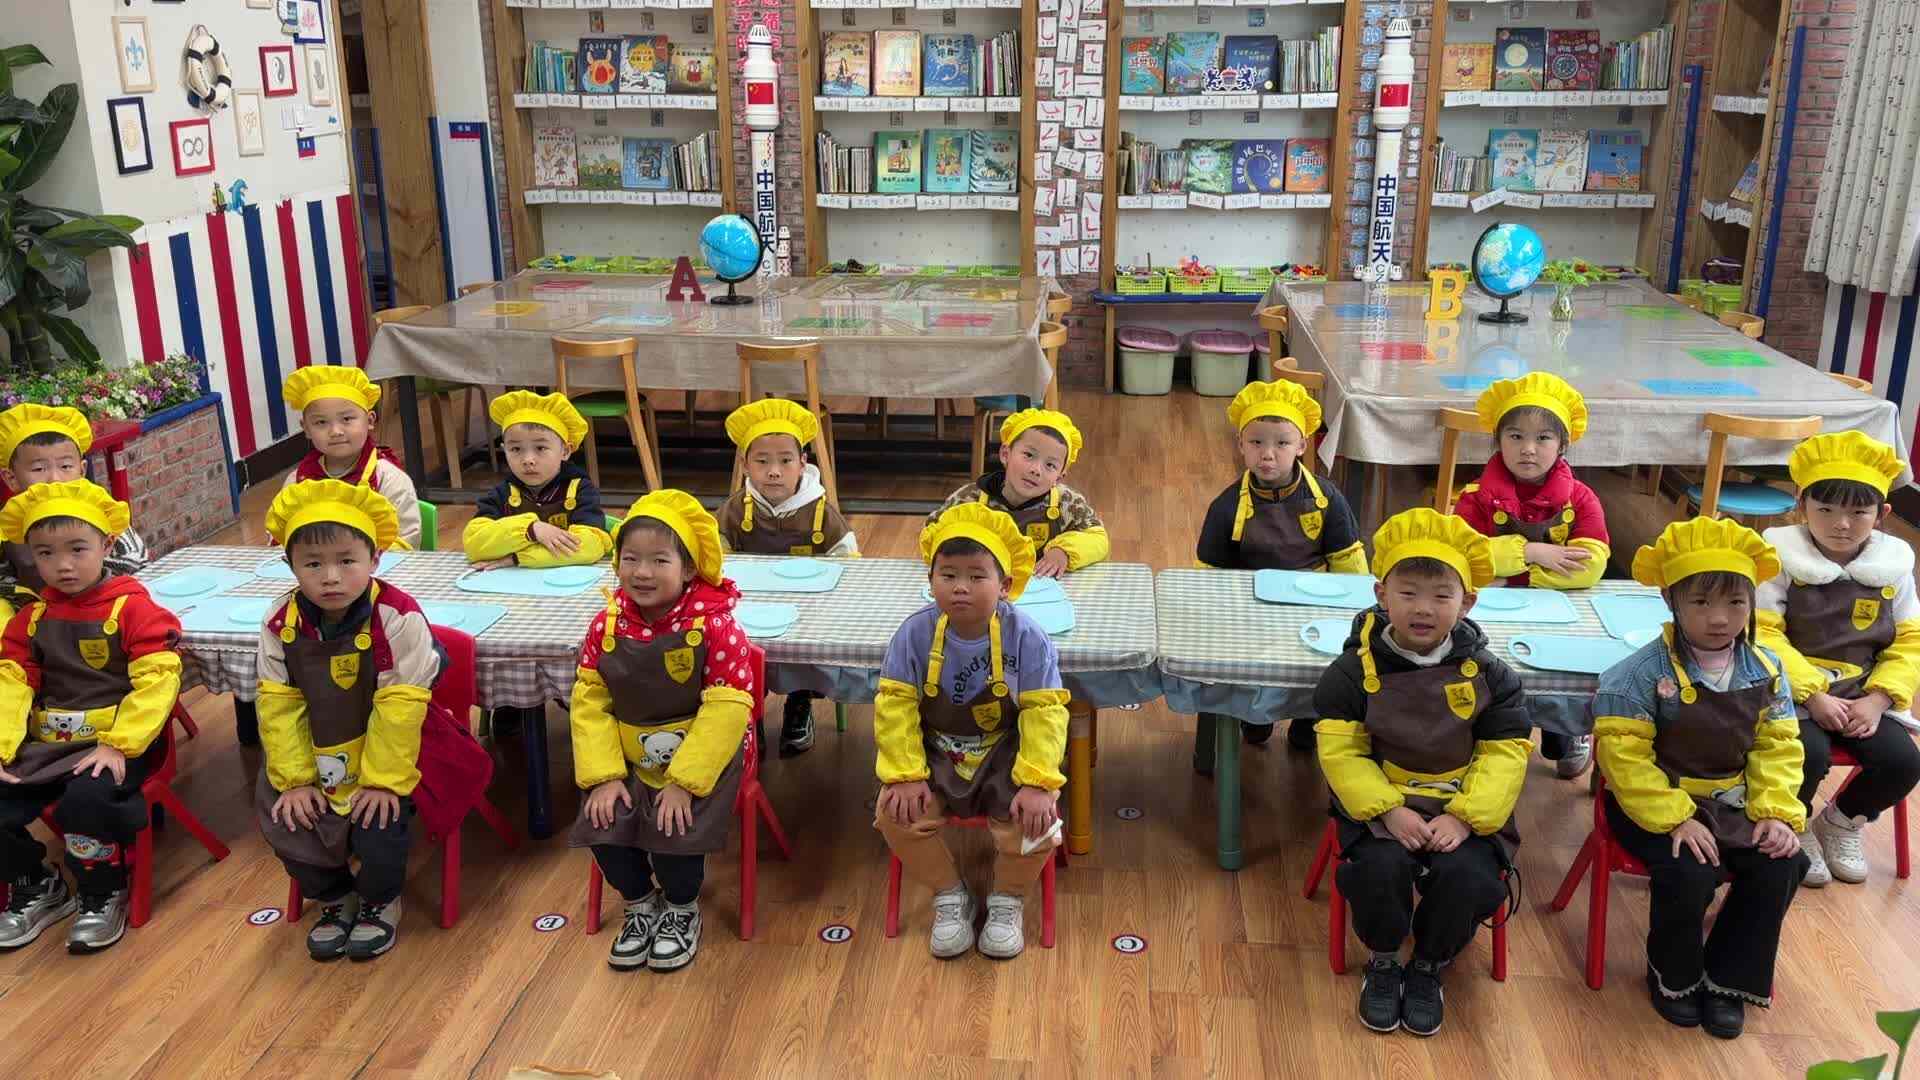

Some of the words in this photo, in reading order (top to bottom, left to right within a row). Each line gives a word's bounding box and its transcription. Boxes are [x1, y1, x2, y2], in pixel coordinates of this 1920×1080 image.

[757, 169, 774, 253] 中国航天
[1372, 174, 1396, 263] 中国航天
[666, 256, 705, 301] A
[1425, 270, 1466, 320] B
[254, 911, 277, 922] F
[540, 917, 560, 929] E
[827, 928, 845, 940] D
[1120, 938, 1137, 950] C
